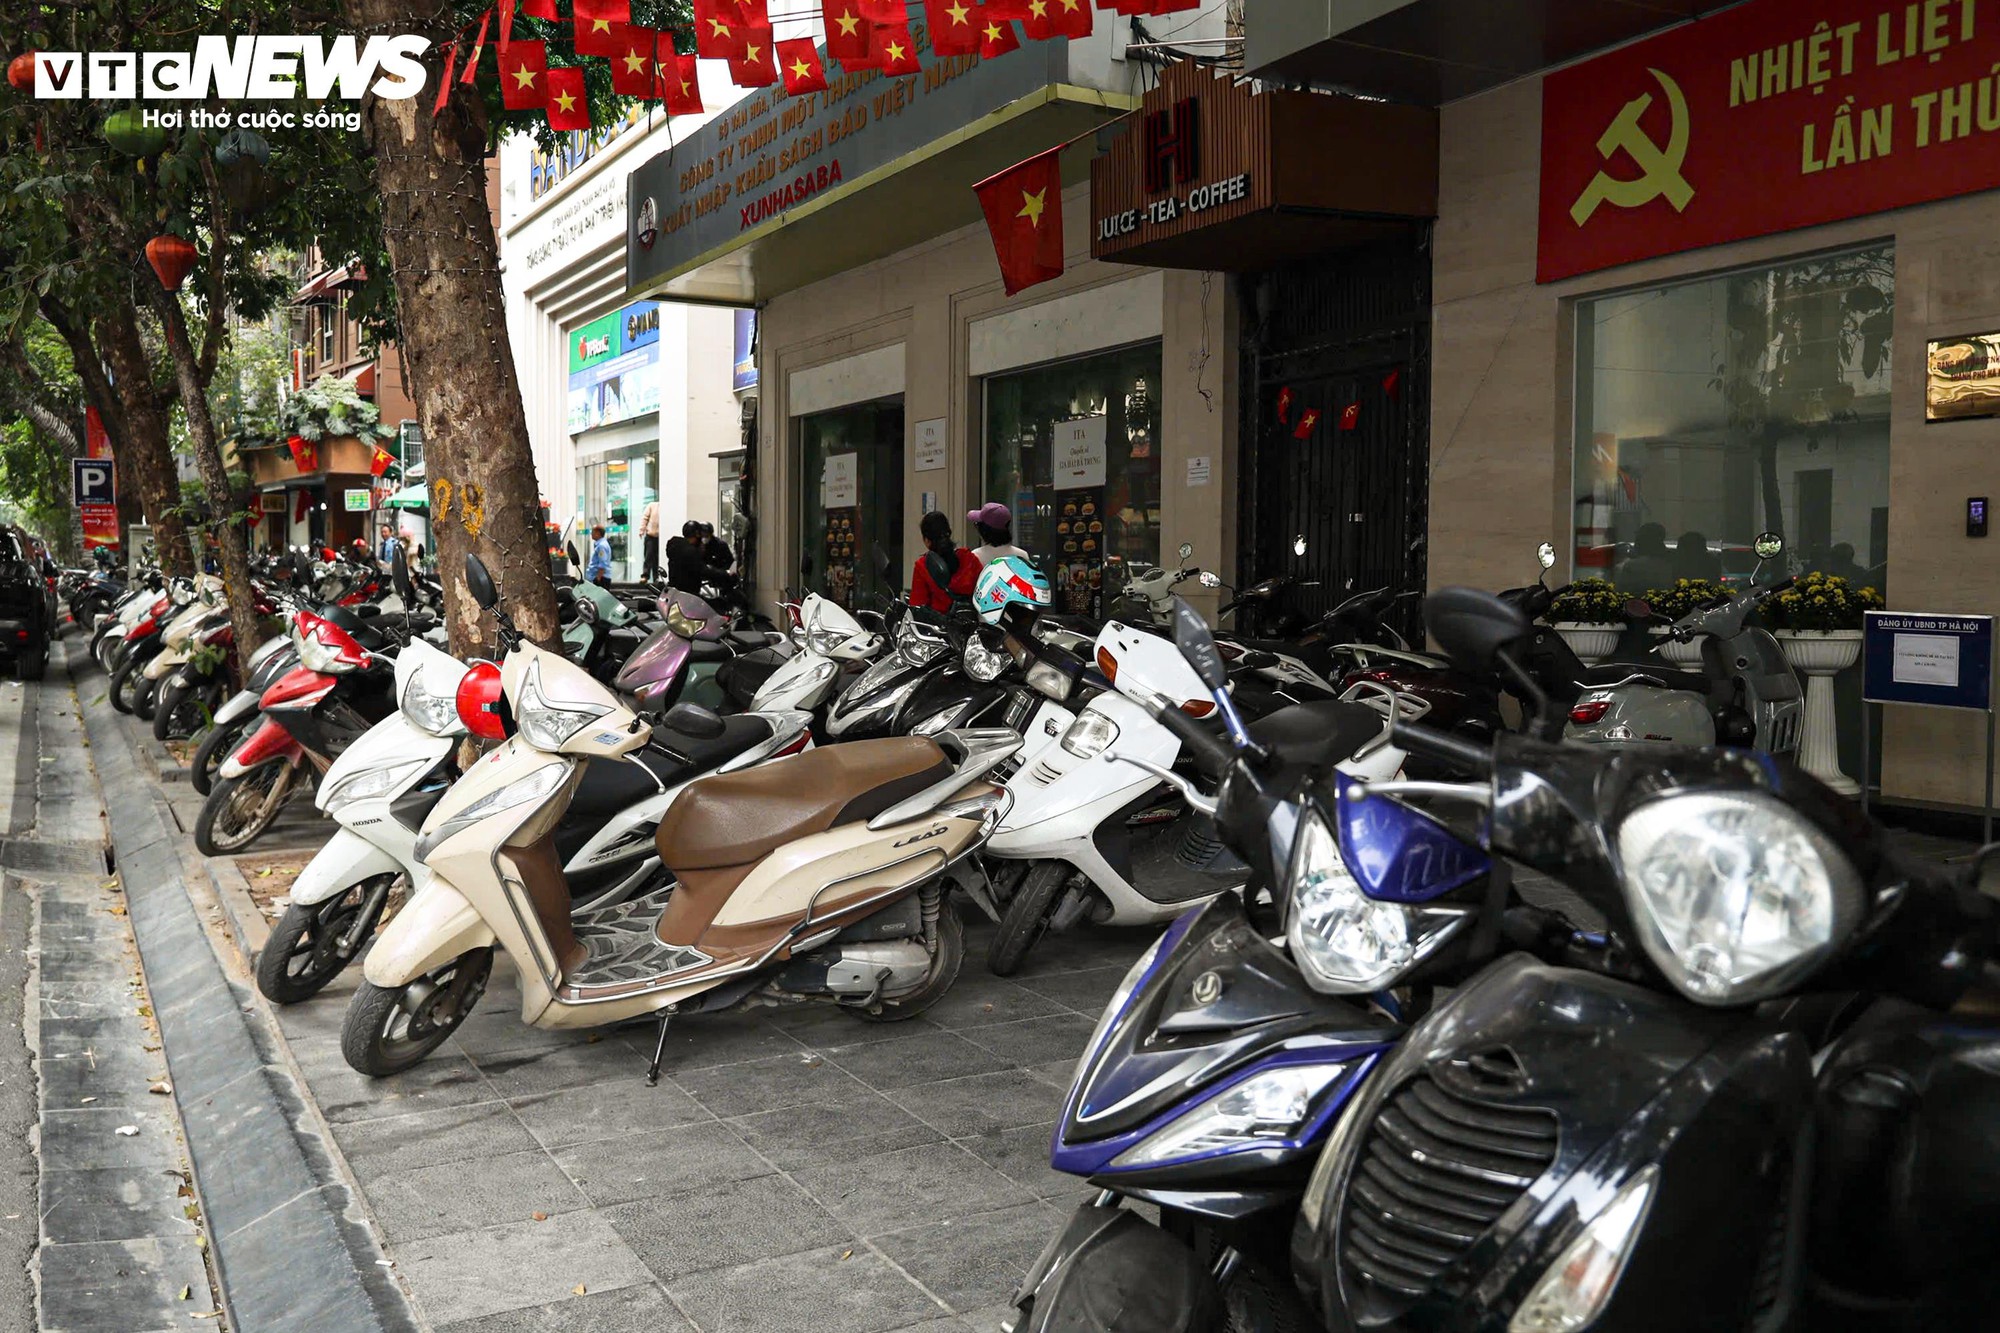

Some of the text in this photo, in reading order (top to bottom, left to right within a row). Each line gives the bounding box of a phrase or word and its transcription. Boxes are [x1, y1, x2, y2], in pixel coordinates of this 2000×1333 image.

[1729, 20, 1861, 109] NHIỆT
[662, 199, 692, 237] XUẤT
[696, 182, 732, 219] NHẬP
[735, 153, 776, 197] KHẨU
[778, 128, 823, 173] SÁCH
[827, 104, 868, 146] BÁO
[873, 77, 918, 122] VIỆT
[924, 52, 979, 95] NAM
[680, 157, 715, 194] CÔNG
[718, 144, 735, 171] TY
[739, 118, 778, 159] TNHH
[782, 94, 816, 135] MỘT
[1801, 95, 1894, 175] LẦN
[740, 159, 843, 231] XUNHASABA
[1188, 174, 1245, 213] COFFEE
[82, 468, 106, 496] P
[1877, 617, 1979, 632] ĐẢNG ỦY UBND TP HÀ NỘI
[352, 817, 383, 827] HONDA
[893, 826, 949, 848] LEAD
